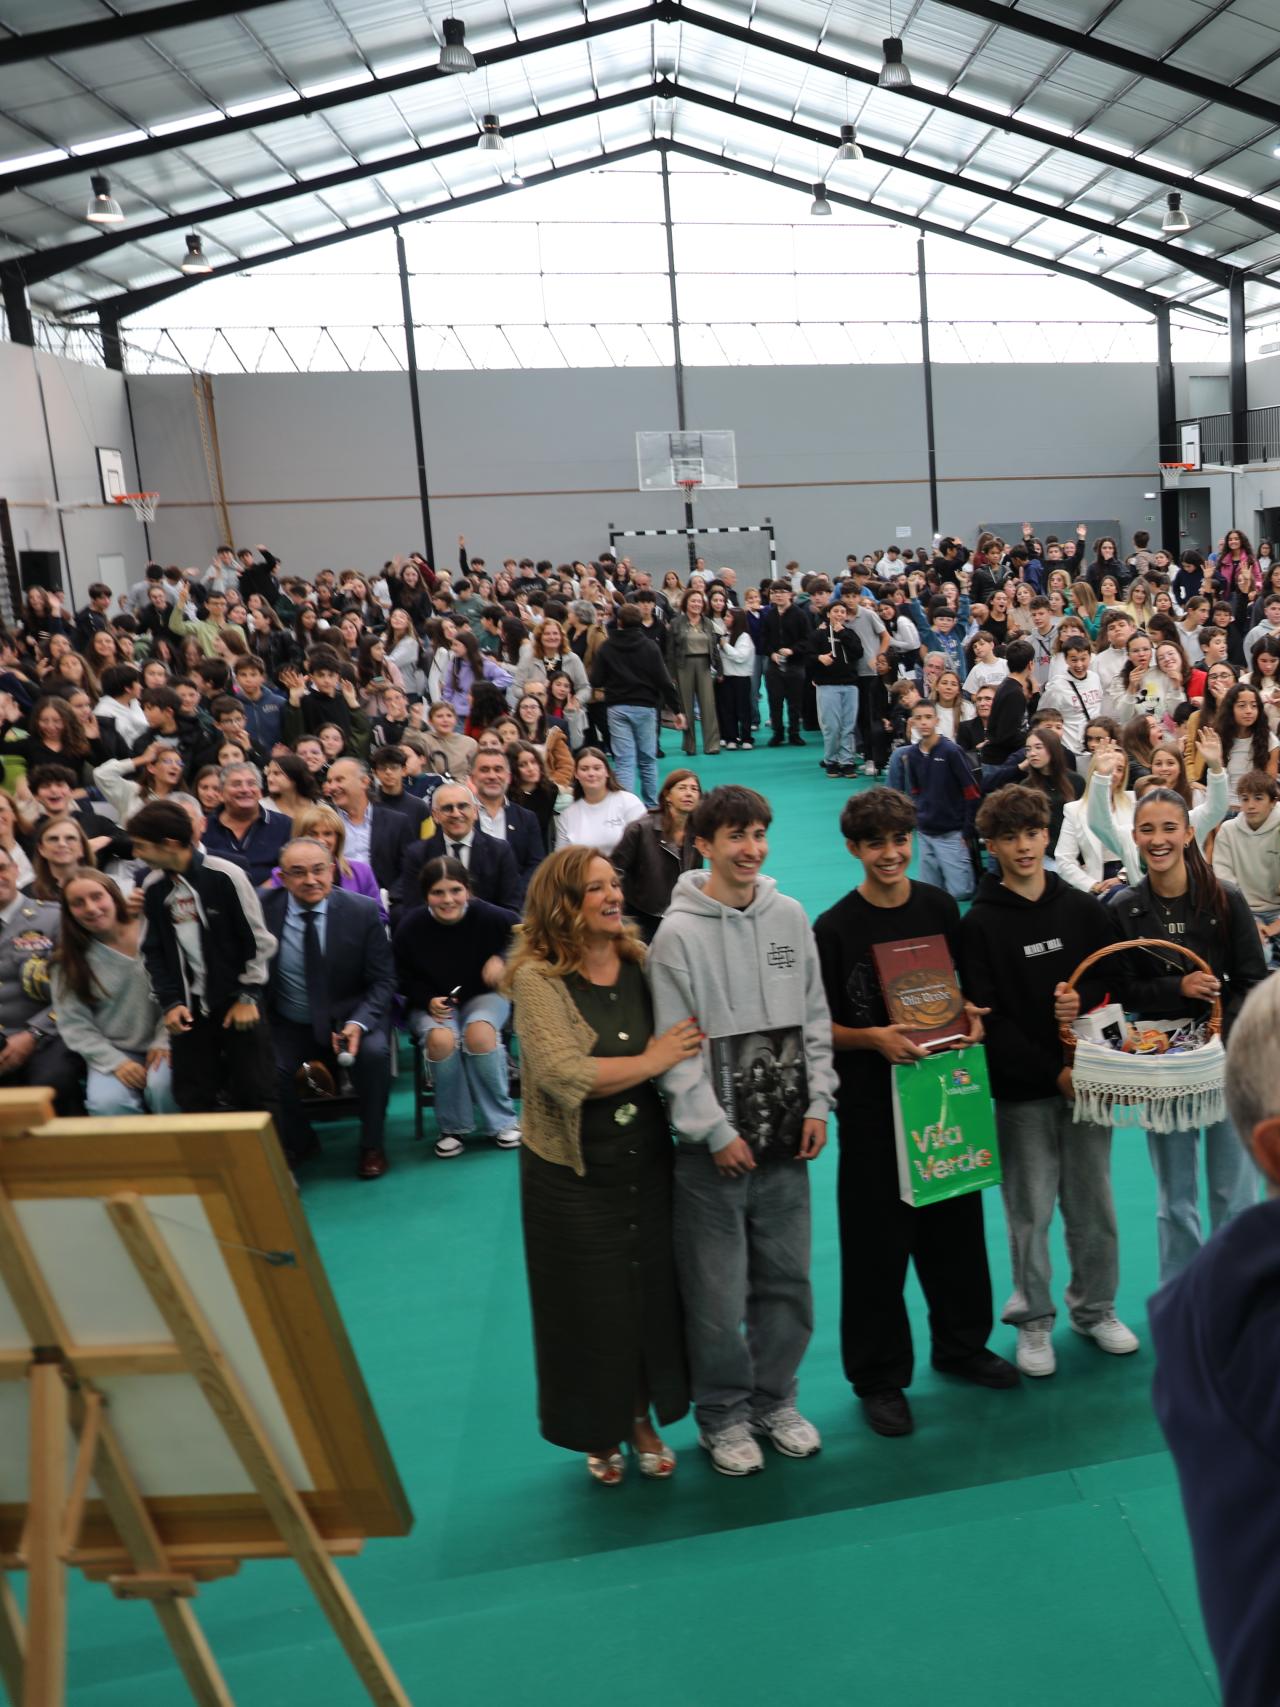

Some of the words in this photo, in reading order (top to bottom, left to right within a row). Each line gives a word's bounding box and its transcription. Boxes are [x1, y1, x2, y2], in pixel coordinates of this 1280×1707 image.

[1164, 922, 1185, 934] OU
[911, 1121, 963, 1153] Vila
[913, 1144, 993, 1181] Verde
